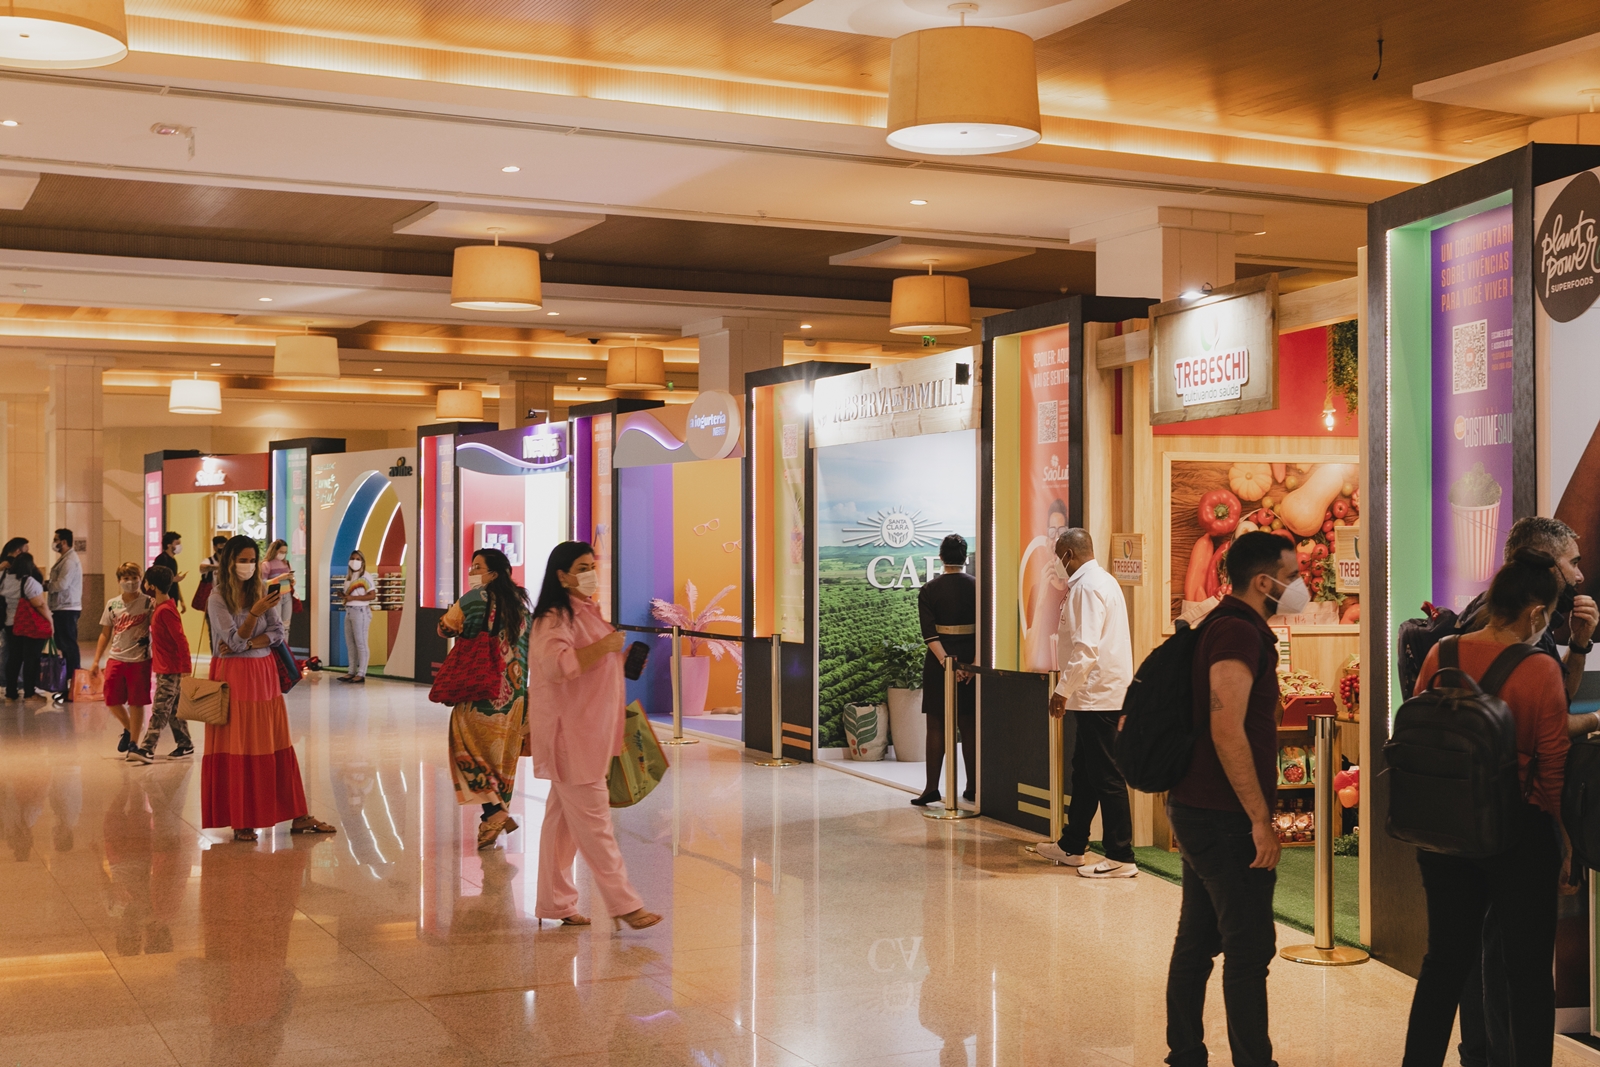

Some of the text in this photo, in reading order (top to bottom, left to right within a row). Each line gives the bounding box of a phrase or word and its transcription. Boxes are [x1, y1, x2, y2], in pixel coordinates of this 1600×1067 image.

[1441, 241, 1453, 263] UM
[1541, 210, 1596, 273] plant
[1441, 251, 1509, 288] SOBRE VIVÊNCIAS
[1546, 225, 1600, 299] power
[1441, 290, 1461, 313] PARA
[1484, 278, 1508, 302] VIVER
[1550, 275, 1594, 294] SUPERFOODS
[1176, 350, 1246, 389] TREBESCHI
[832, 386, 892, 423] RESERVA
[1184, 384, 1240, 403] cultivando saúde
[694, 410, 727, 430] iogurteria
[1339, 561, 1360, 578] TREB
